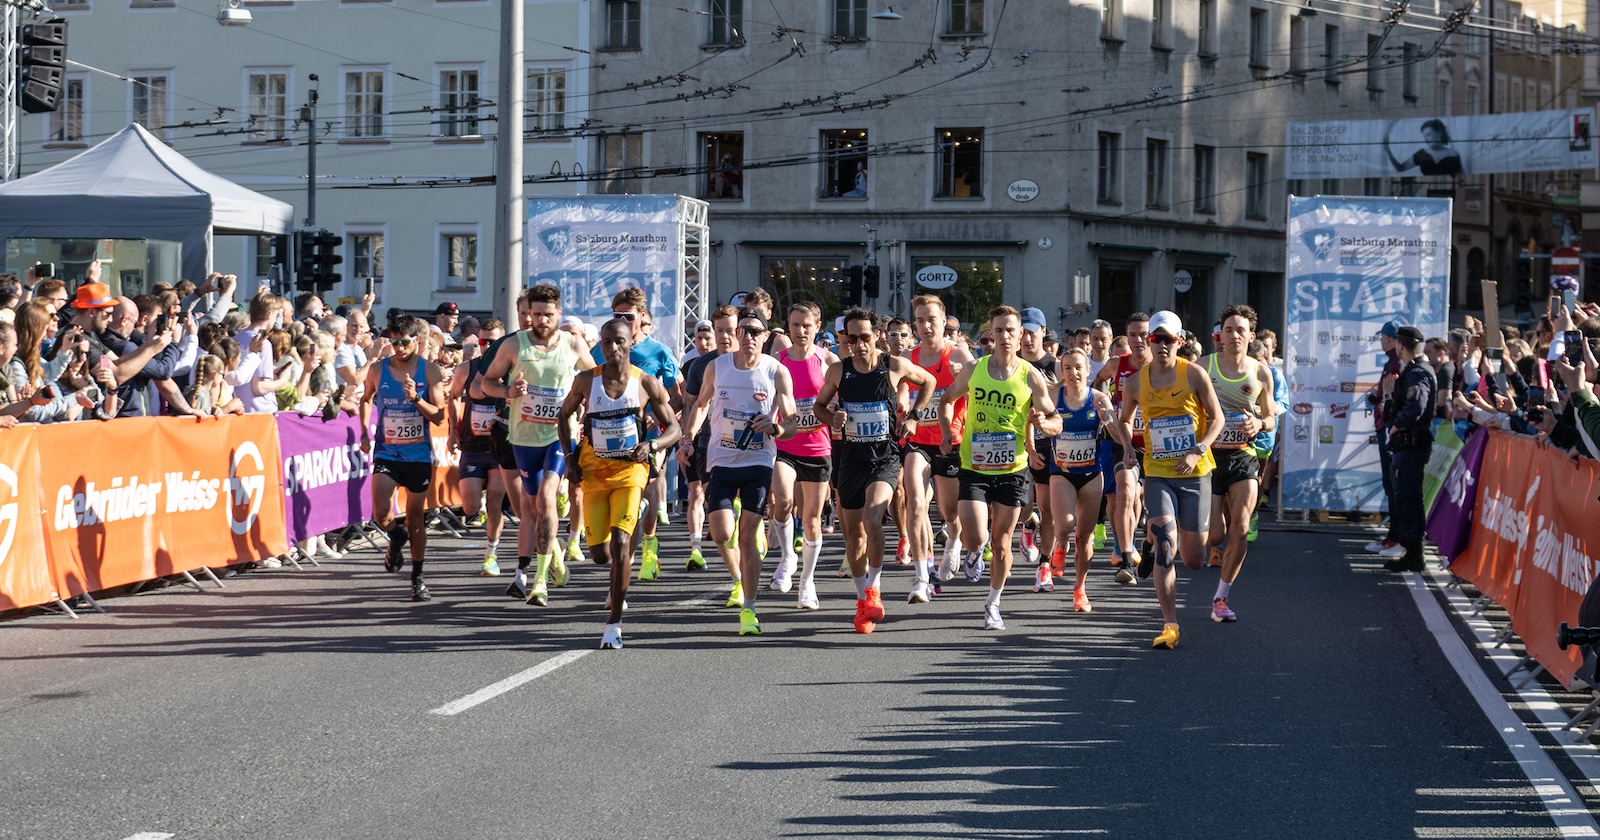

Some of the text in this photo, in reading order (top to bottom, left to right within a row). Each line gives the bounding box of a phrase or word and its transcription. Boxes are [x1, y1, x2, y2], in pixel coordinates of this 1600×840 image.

[1291, 126, 1348, 135] SALZBURGER
[1291, 136, 1340, 145] FESTSPIELE
[1291, 145, 1340, 154] PFINGSTEN
[1338, 154, 1359, 163] 2024
[575, 233, 667, 245] Salzburg Marathon
[1041, 238, 1048, 246] 2
[1340, 237, 1437, 248] Salzburg Marathon
[1295, 280, 1441, 314] START
[383, 397, 399, 405] RUN
[974, 387, 1017, 407] DNA
[534, 404, 561, 418] 3952
[858, 421, 887, 436] 1123
[1152, 419, 1184, 428] SPARKASSE
[397, 424, 422, 437] 2589
[618, 437, 628, 451] 2
[1168, 435, 1191, 451] 193
[986, 450, 1014, 464] 2655
[1069, 448, 1094, 461] 4667
[284, 442, 369, 496] SPARKASSE
[54, 470, 221, 532] Gebrüder Weiss
